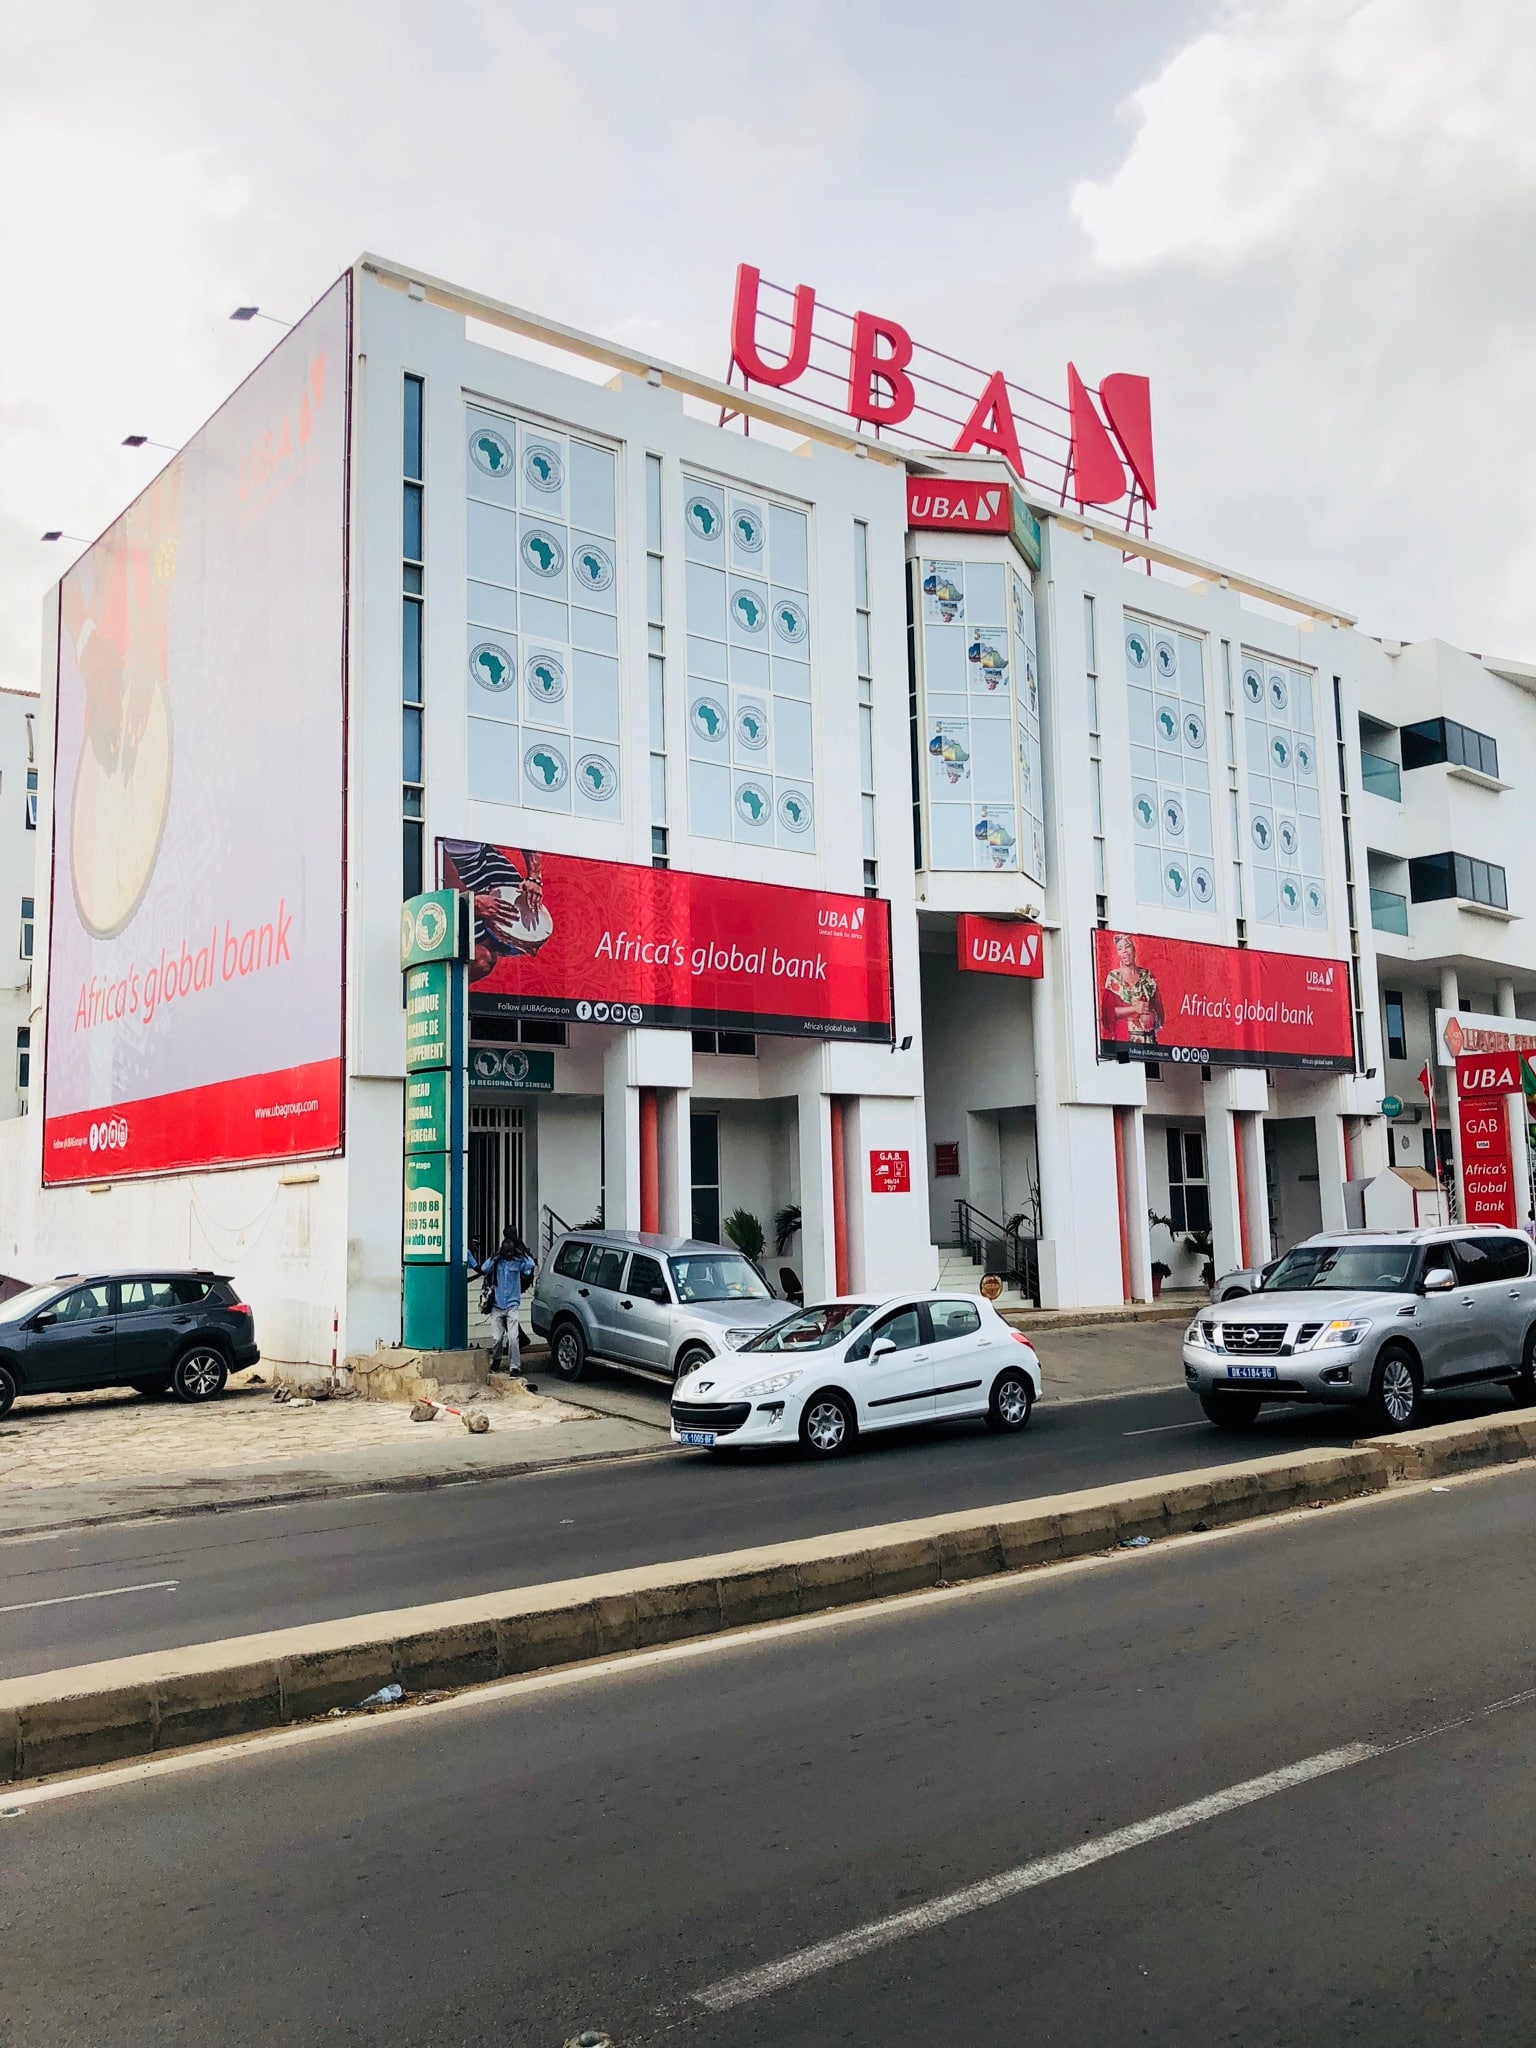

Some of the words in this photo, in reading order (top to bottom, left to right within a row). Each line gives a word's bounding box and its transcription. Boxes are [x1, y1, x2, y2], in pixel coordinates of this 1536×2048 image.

[730, 263, 1025, 478] UBA
[911, 495, 969, 520] UBA
[818, 910, 848, 929] UBA
[594, 931, 686, 966] Africa's
[691, 942, 766, 975] global
[772, 948, 827, 980] bank
[972, 938, 1016, 965] UBA
[74, 962, 141, 1032] Africa's
[142, 925, 217, 1024] global
[222, 898, 293, 982] bank
[1306, 971, 1325, 985] UBA
[498, 1002, 520, 1011] Follow
[521, 1004, 561, 1015] @UBAGroup
[1180, 994, 1231, 1019] Africa's
[1234, 999, 1278, 1026] global
[1281, 1002, 1314, 1026] bank
[429, 1019, 438, 1035] DE
[803, 1022, 824, 1031] Africa's
[824, 1024, 842, 1032] global
[843, 1025, 857, 1033] bank
[477, 1079, 513, 1087] REGIONAL
[1462, 1067, 1514, 1089] UBA
[254, 1099, 319, 1119] www.ubagroup.com
[1465, 1118, 1498, 1134] GAB
[880, 1152, 902, 1161] G.A.B.
[1465, 1163, 1507, 1176] Africa's
[1468, 1181, 1507, 1194] Global
[429, 1200, 439, 1212] 88
[1475, 1200, 1505, 1212] Bank
[418, 1218, 427, 1230] 75
[429, 1218, 439, 1229] 44
